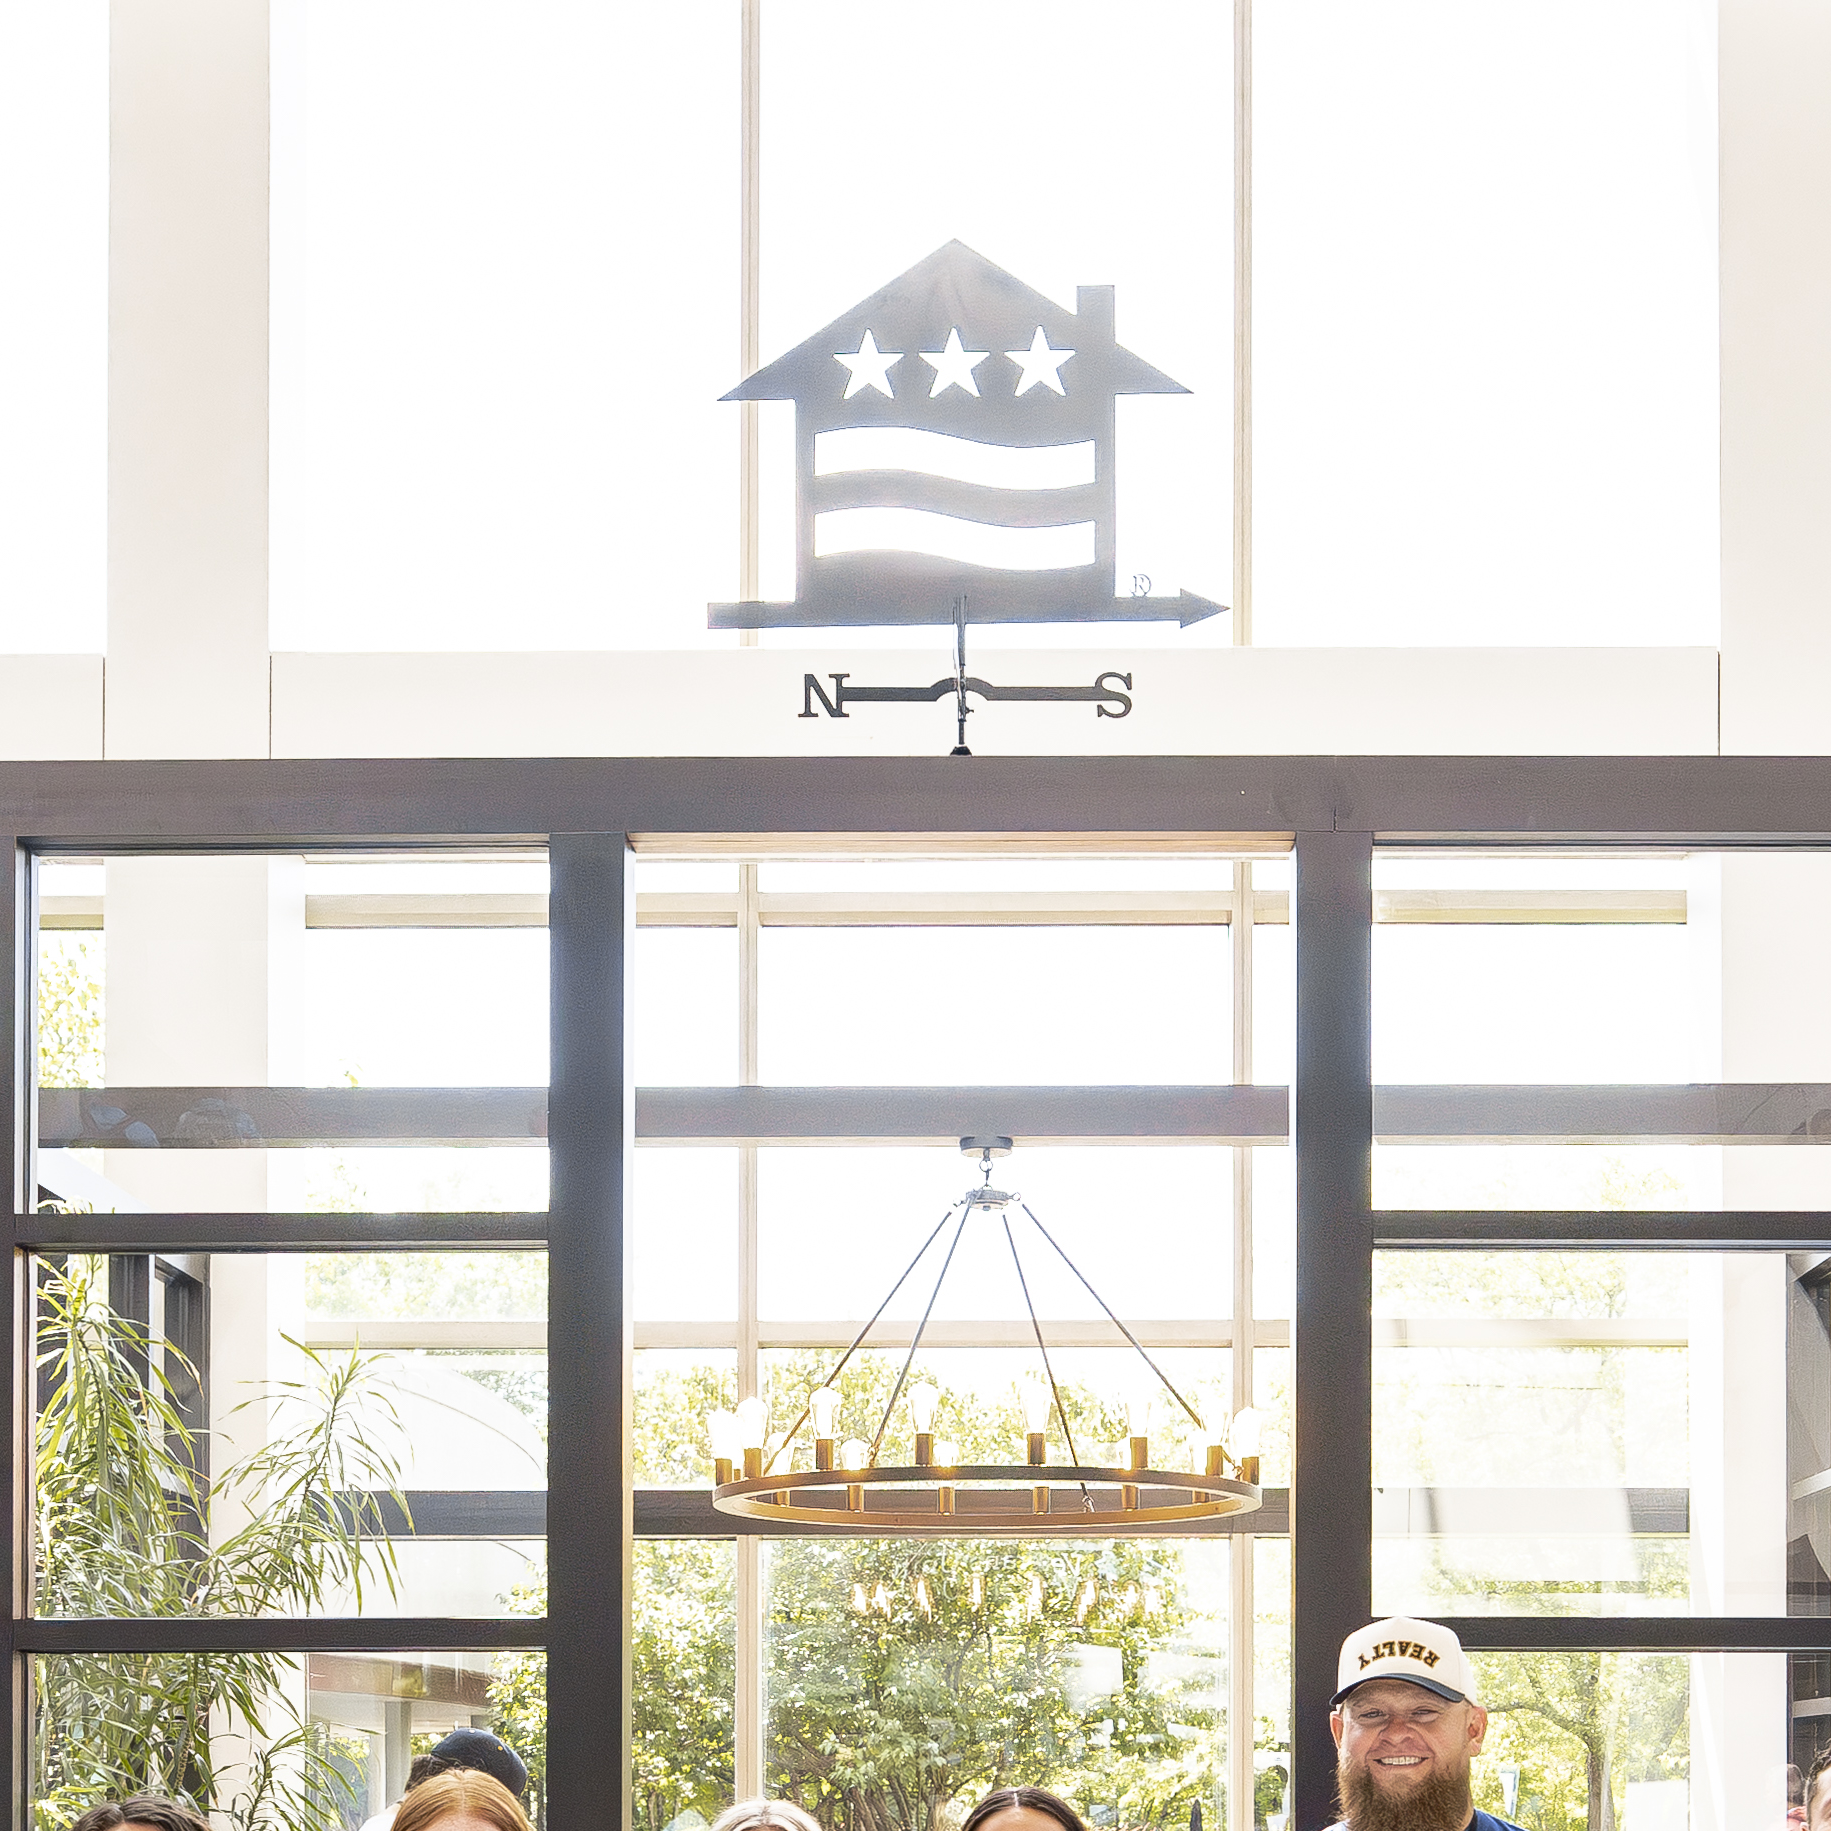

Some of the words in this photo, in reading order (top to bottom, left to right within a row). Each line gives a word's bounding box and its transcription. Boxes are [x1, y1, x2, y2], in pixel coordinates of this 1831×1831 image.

[798, 673, 850, 717] N
[1095, 671, 1133, 717] S
[1358, 1640, 1440, 1671] REALTY
